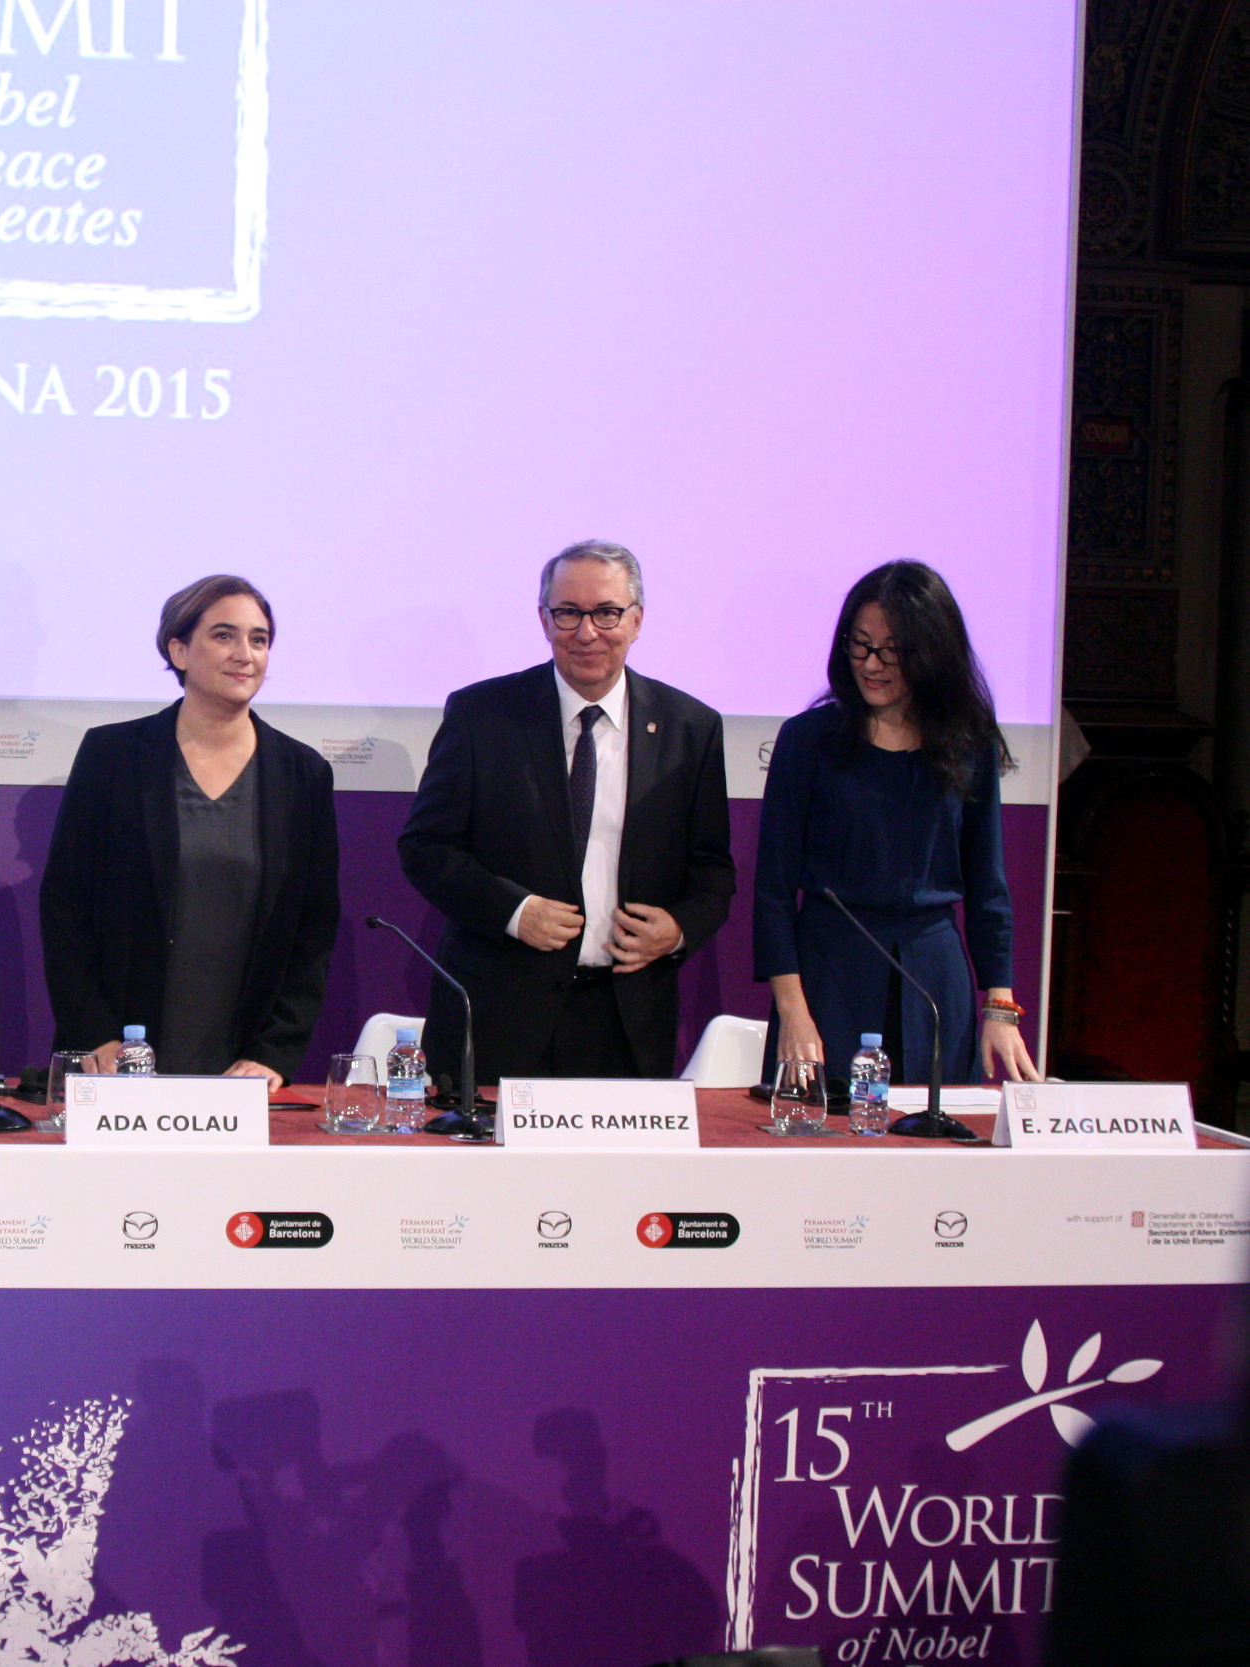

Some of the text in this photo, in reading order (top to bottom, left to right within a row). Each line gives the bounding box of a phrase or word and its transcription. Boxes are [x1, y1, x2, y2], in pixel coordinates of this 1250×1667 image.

[92, 365, 232, 419] 2015
[96, 1115, 239, 1132] ADA COLAU
[513, 1110, 690, 1130] DÍDAC RAMIREZ
[1022, 1118, 1183, 1134] E. ZAGLADINA
[269, 1220, 310, 1228] Ajuntament
[678, 1220, 717, 1229] Ajuntament
[269, 1228, 321, 1238] Barcelona
[678, 1229, 728, 1239] Barcelona
[837, 1625, 992, 1667] of Nobel
